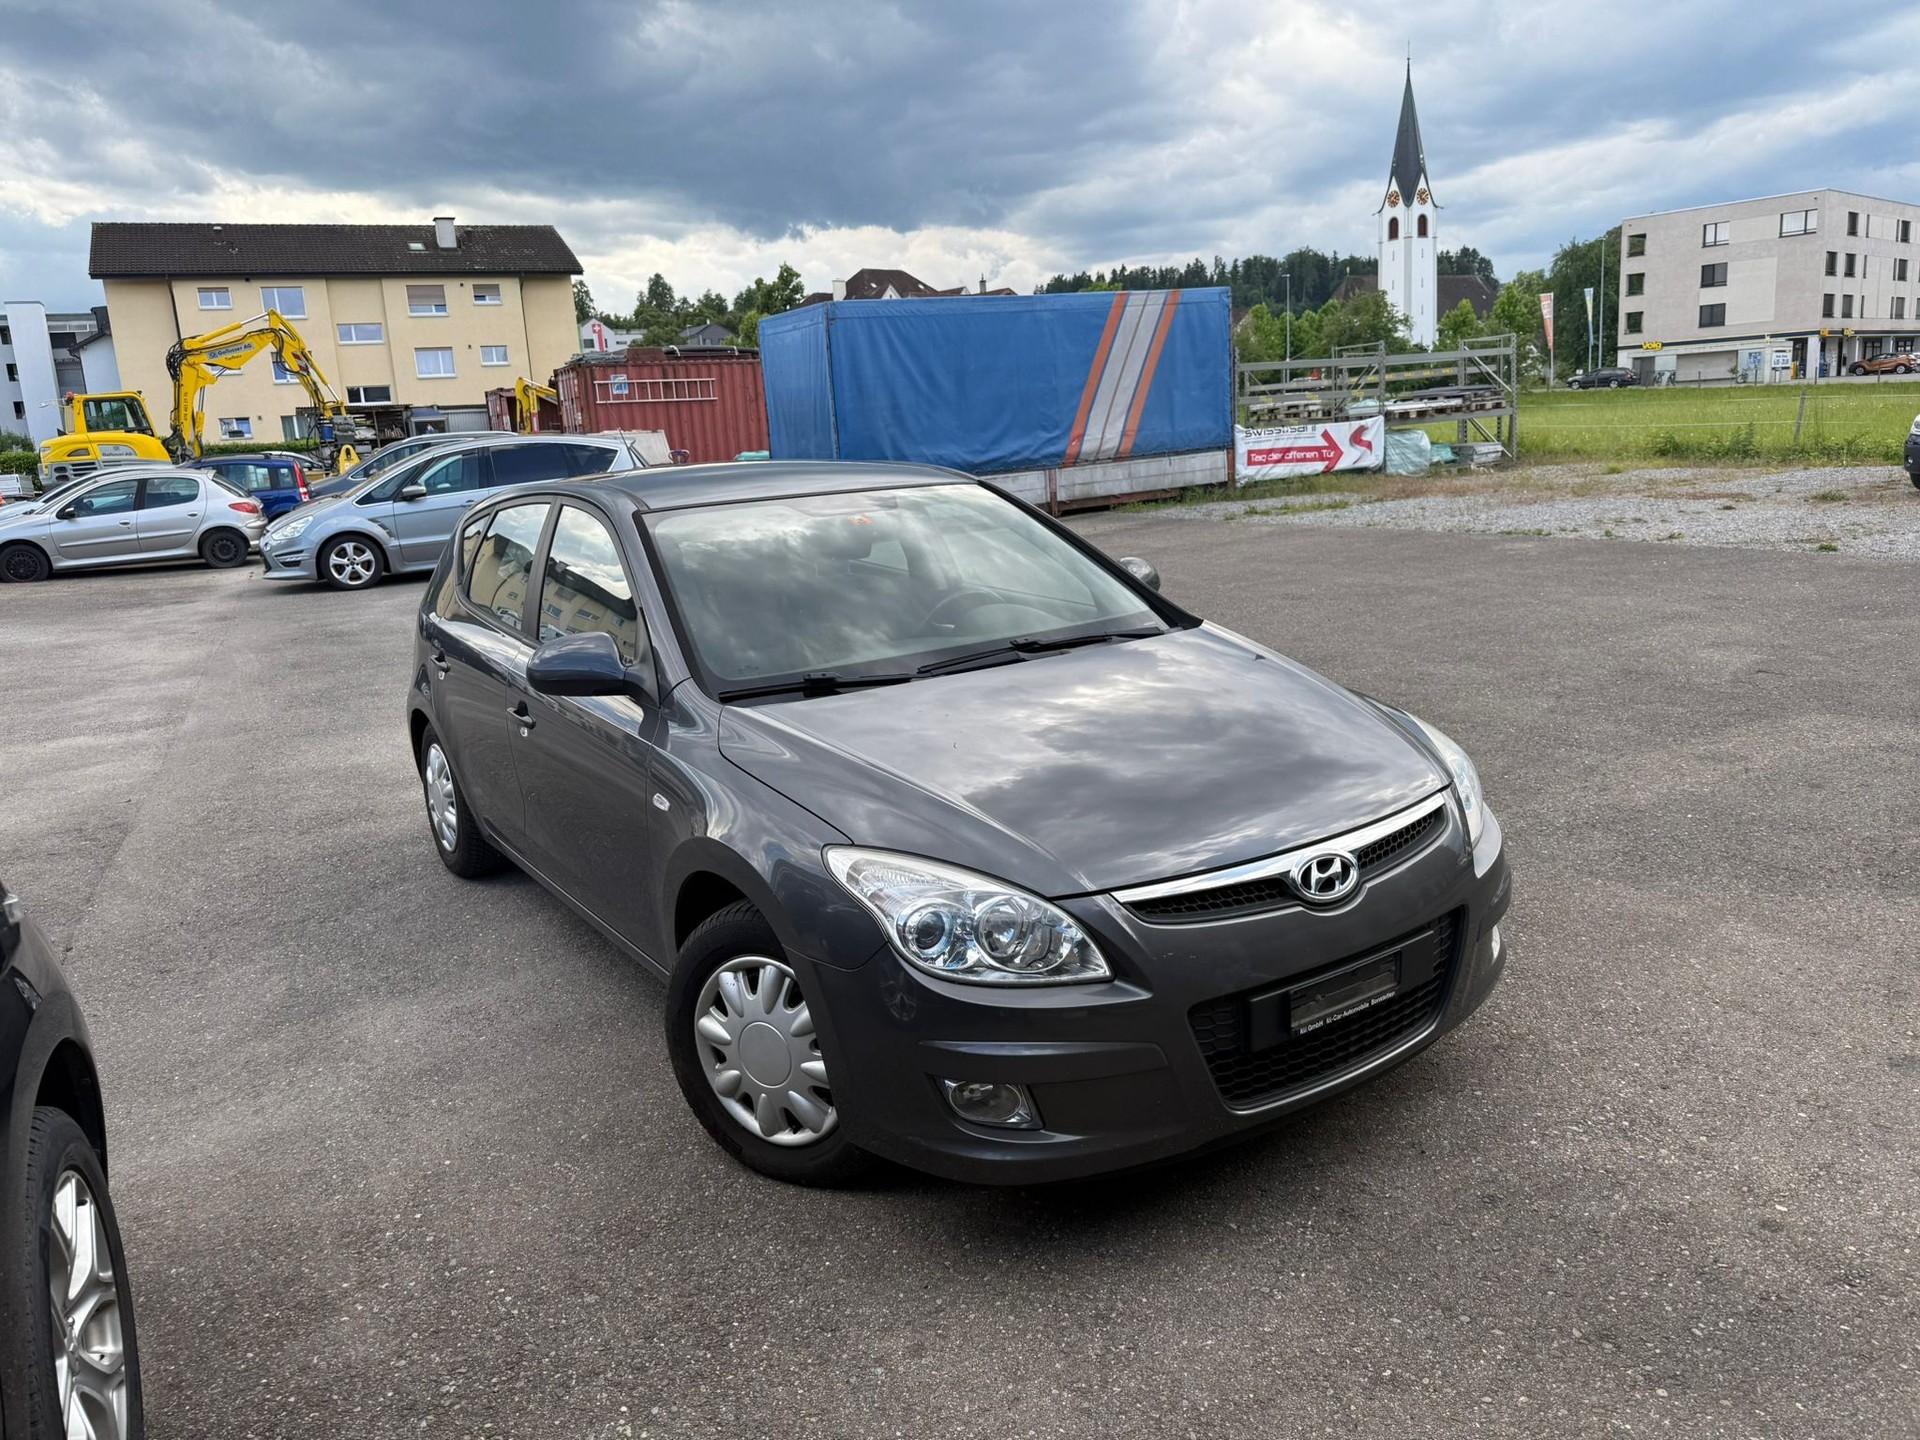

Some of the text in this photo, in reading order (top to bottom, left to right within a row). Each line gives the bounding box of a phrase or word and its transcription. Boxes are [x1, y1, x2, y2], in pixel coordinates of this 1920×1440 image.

[1642, 341, 1662, 351] Volg
[1250, 449, 1335, 462] Tag der offenen Tür
[1307, 1020, 1324, 1032] GmbH
